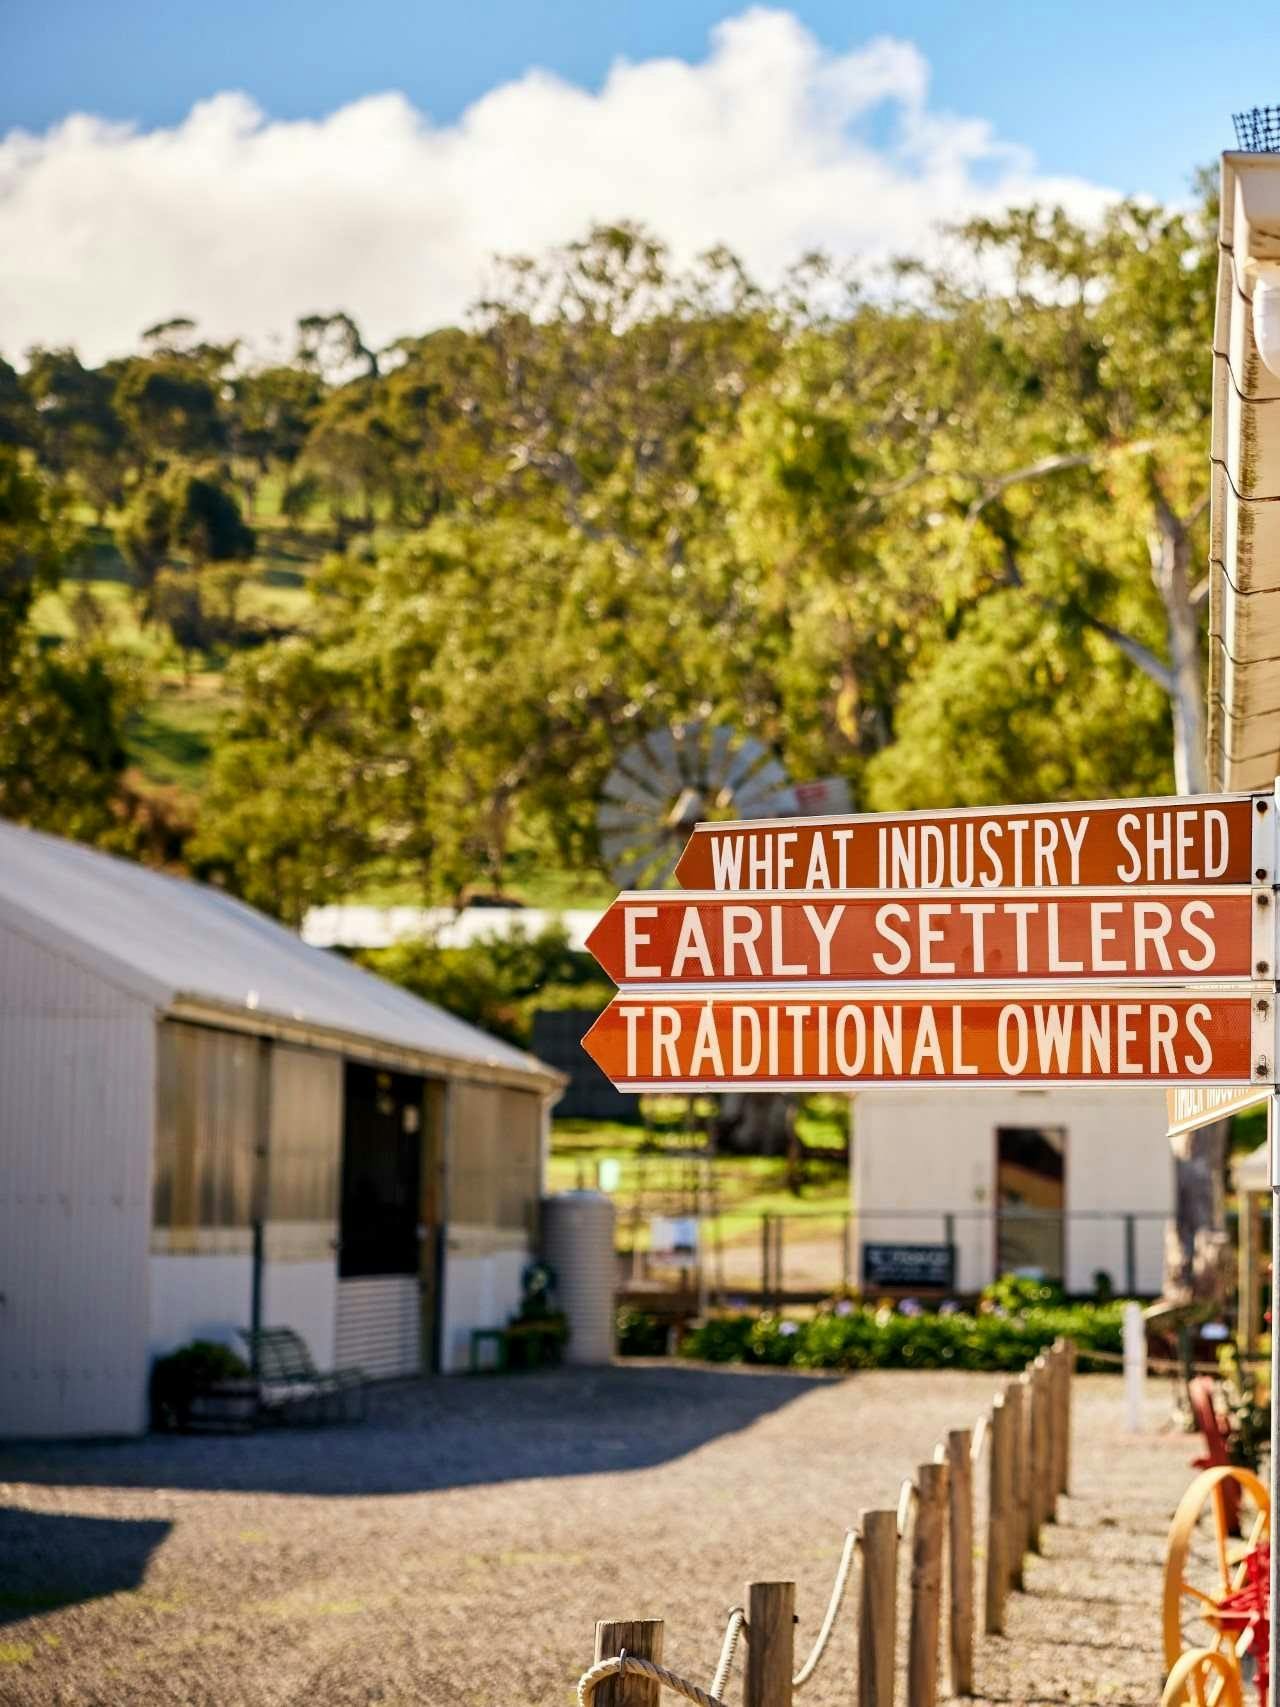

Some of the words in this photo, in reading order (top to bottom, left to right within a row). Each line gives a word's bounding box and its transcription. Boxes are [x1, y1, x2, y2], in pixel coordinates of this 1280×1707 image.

[710, 829, 854, 890] WHEAT
[878, 817, 1090, 889] INDUSTRY
[1116, 809, 1230, 884] SHED
[623, 904, 845, 977] EARLY
[872, 900, 1217, 975] SETTLERS
[619, 1004, 979, 1077] TRADITIONAL
[997, 1003, 1213, 1076] OWNERS
